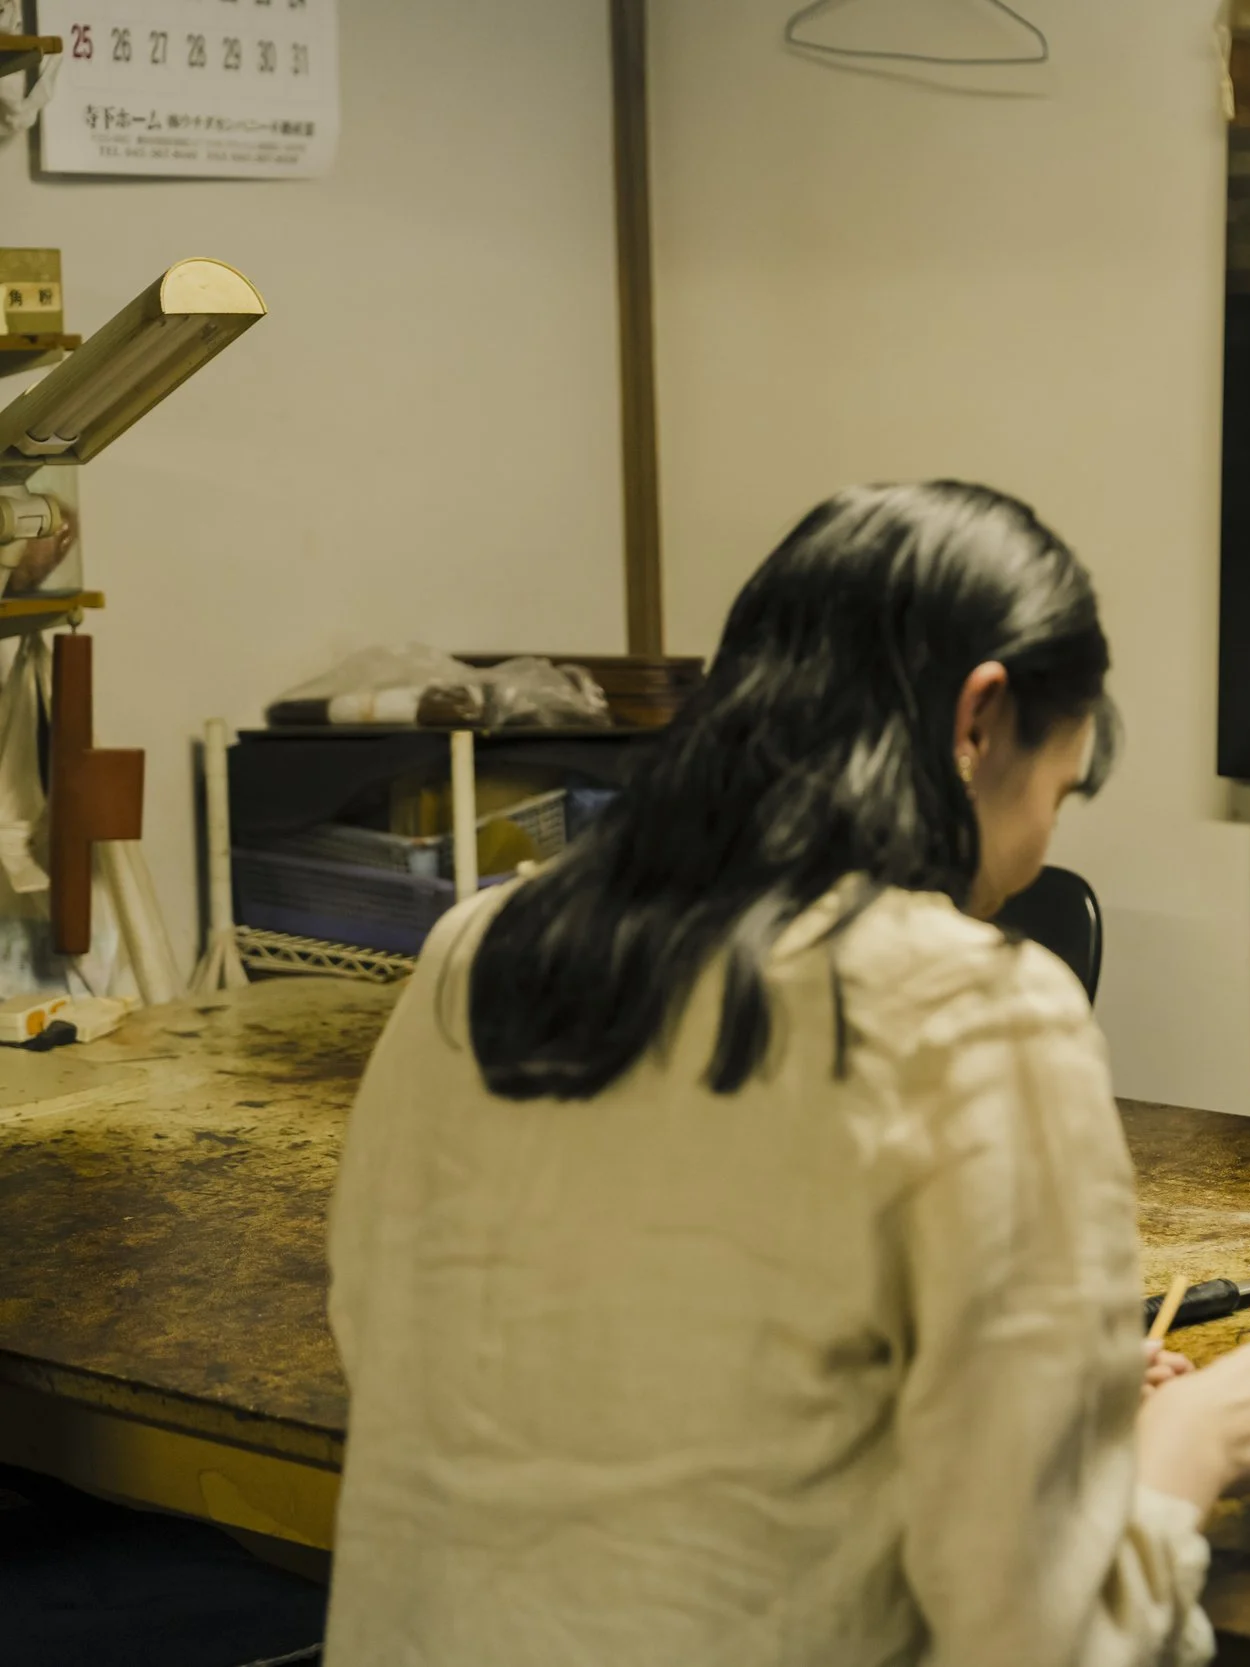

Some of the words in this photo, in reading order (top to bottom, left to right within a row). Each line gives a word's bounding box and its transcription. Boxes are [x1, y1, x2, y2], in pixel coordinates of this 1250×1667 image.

[71, 23, 93, 60] 25
[110, 27, 132, 63] 26
[149, 30, 168, 65] 27
[187, 33, 207, 69] 28
[222, 36, 242, 71] 29
[257, 40, 277, 74] 30
[292, 42, 309, 76] 31
